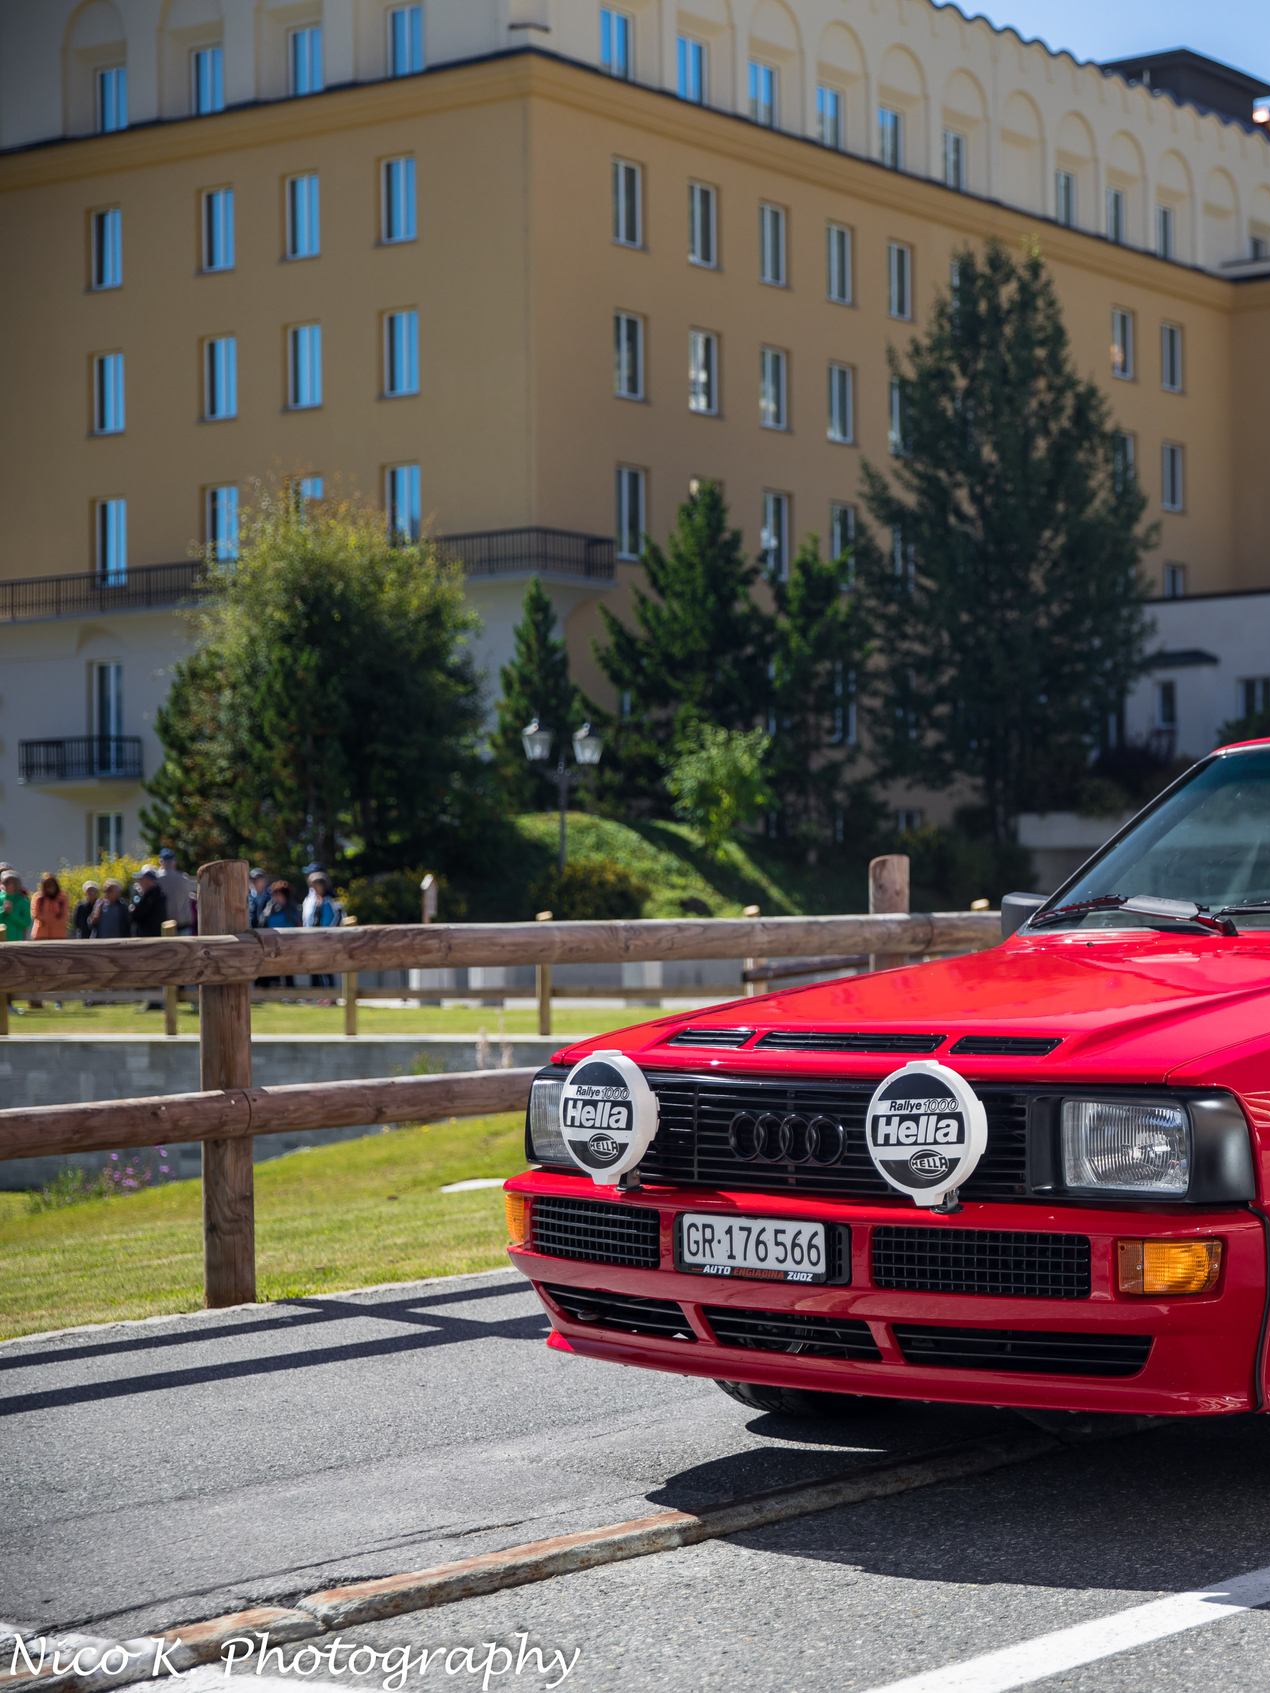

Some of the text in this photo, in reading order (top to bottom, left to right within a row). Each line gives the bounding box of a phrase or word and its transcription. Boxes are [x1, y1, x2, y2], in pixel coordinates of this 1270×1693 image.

[576, 1086, 630, 1100] Rallye 1000
[889, 1098, 960, 1113] Rallye 1000
[566, 1099, 629, 1129] Hella
[877, 1115, 959, 1145] Hella
[590, 1139, 619, 1154] HELLA
[911, 1155, 949, 1170] HELLA
[703, 1265, 814, 1282] AUTO ENGIADINA ZUOZ
